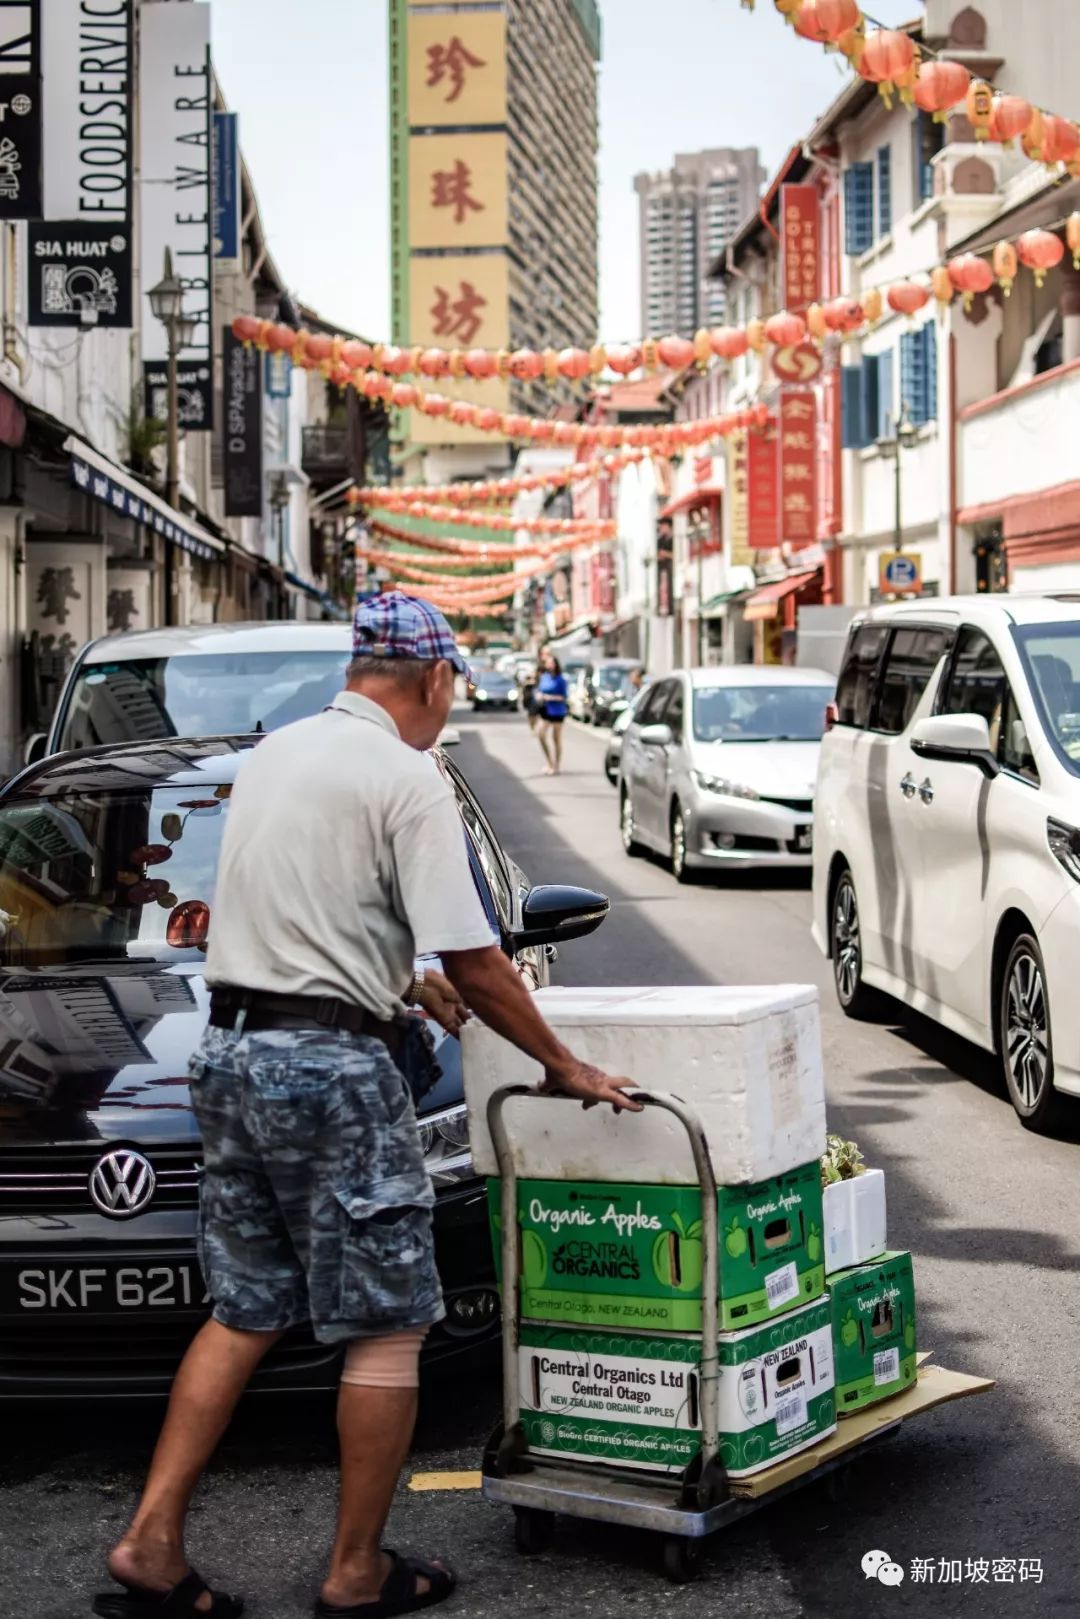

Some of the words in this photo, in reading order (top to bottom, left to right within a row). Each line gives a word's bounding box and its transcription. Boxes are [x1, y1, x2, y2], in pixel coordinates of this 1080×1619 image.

[426, 36, 489, 346] 珍珠坊
[174, 64, 208, 348] ABLEWARE
[34, 240, 63, 257] SIA
[66, 241, 109, 257] HUAT
[786, 205, 801, 298] GOLDEN
[802, 220, 816, 302] TRAVE
[530, 1199, 597, 1233] Organic
[601, 1200, 662, 1237] Apples
[747, 1200, 778, 1222] Organic
[566, 1240, 639, 1262] CENTRAL
[552, 1257, 641, 1280] ORGANICS
[18, 1269, 107, 1308] SKF
[115, 1266, 212, 1306] 621
[529, 1299, 562, 1311] Central
[598, 1304, 620, 1315] NEW
[622, 1306, 668, 1319] ZEALAND
[763, 1353, 780, 1368] NEW
[780, 1339, 808, 1361] ZEALAND
[540, 1356, 590, 1378] Central
[593, 1363, 656, 1384] Organics
[660, 1370, 684, 1388] Ltd
[572, 1381, 614, 1399] Central
[616, 1387, 651, 1404] Otago
[550, 1394, 568, 1405] NEW
[569, 1397, 604, 1411] ZEALAND
[606, 1402, 642, 1415] ORGANIC
[643, 1406, 676, 1418] APPLES
[558, 1429, 583, 1440] BioGro
[583, 1433, 622, 1446] CERTIFIED
[623, 1438, 659, 1451] ORGANIC
